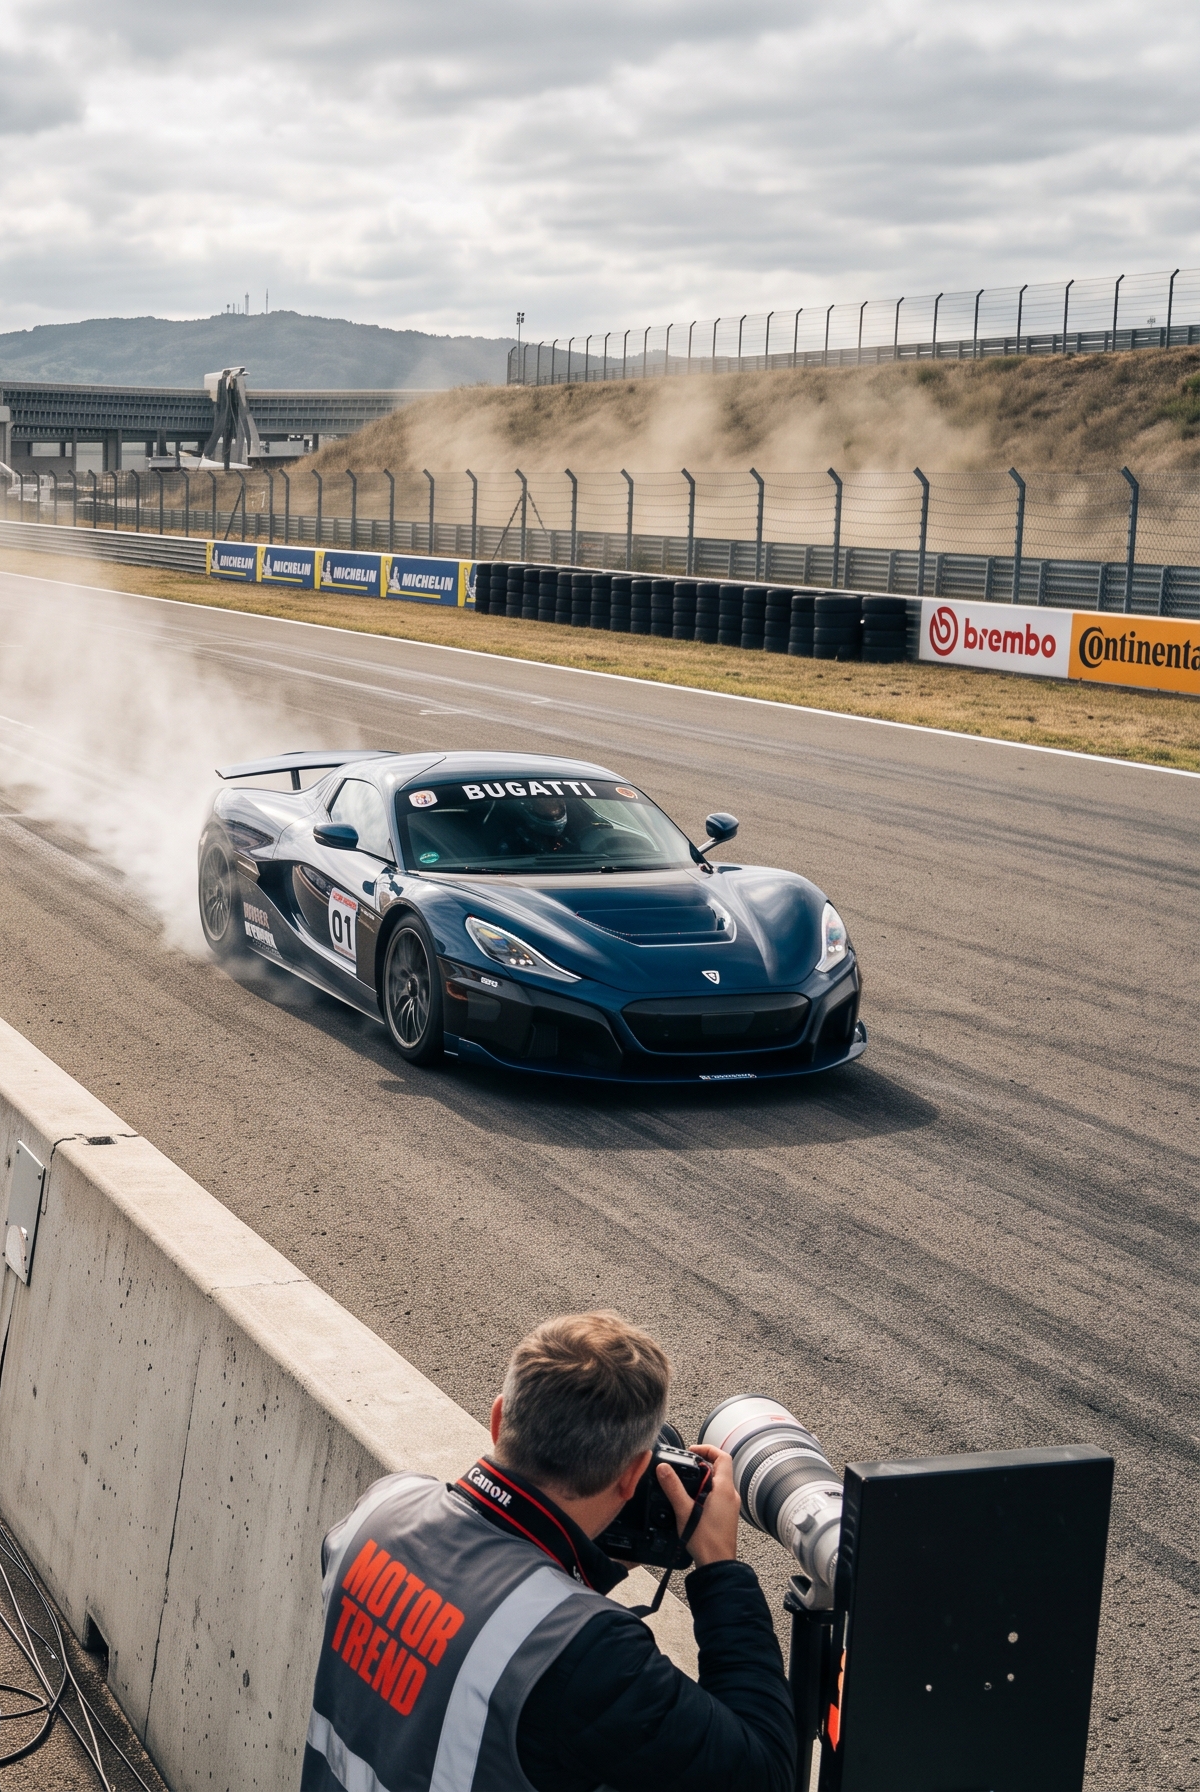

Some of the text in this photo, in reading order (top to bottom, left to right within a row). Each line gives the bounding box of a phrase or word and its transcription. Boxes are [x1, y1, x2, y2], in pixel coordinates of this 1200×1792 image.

[333, 566, 377, 583] MICHELIN
[401, 573, 454, 591] MICHELIN
[963, 617, 1057, 659] brembo
[461, 781, 597, 800] BUGATTI
[332, 909, 353, 951] 01
[341, 1538, 466, 1667] MOTOR
[331, 1595, 428, 1717] TREND
